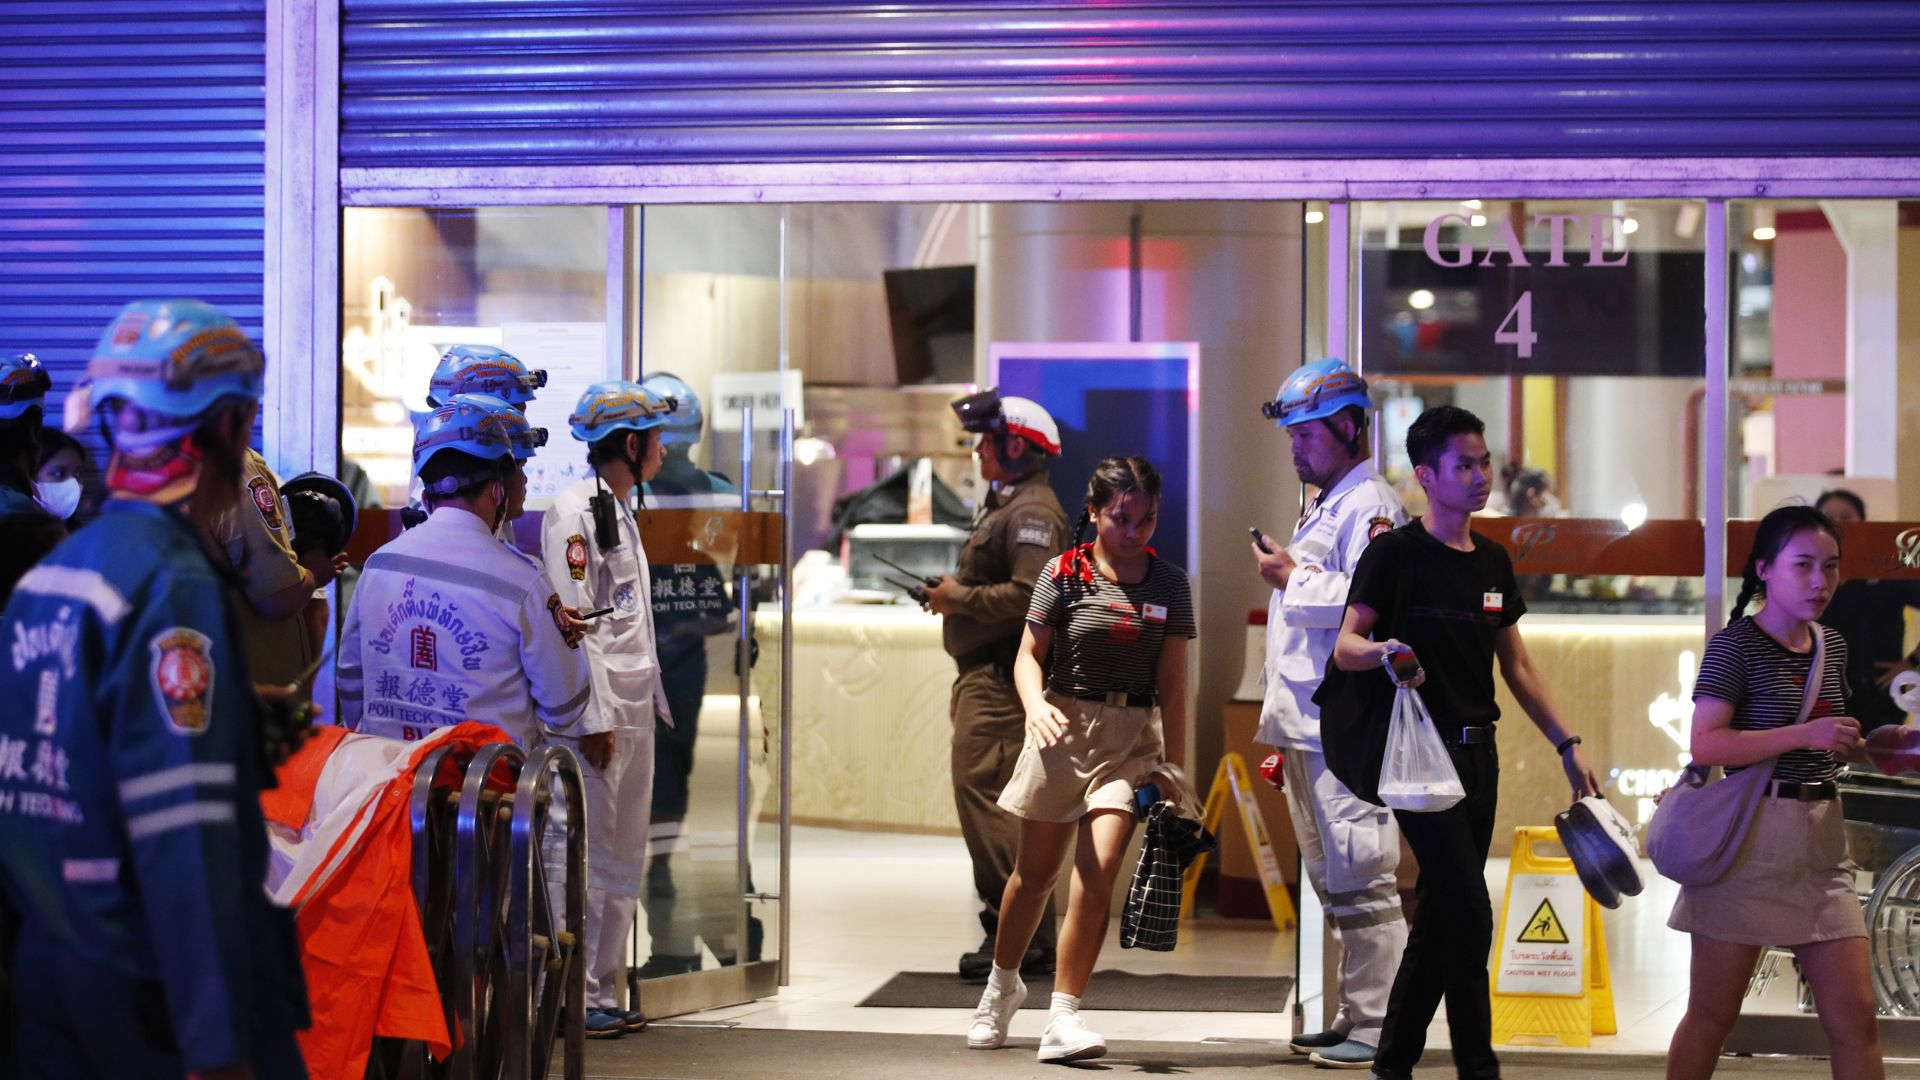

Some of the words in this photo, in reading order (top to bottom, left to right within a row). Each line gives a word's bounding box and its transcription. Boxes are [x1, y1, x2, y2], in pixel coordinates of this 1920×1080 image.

[1423, 213, 1630, 268] GATE
[1494, 290, 1538, 358] 4
[367, 702, 395, 718] POH
[398, 708, 434, 724] TECK
